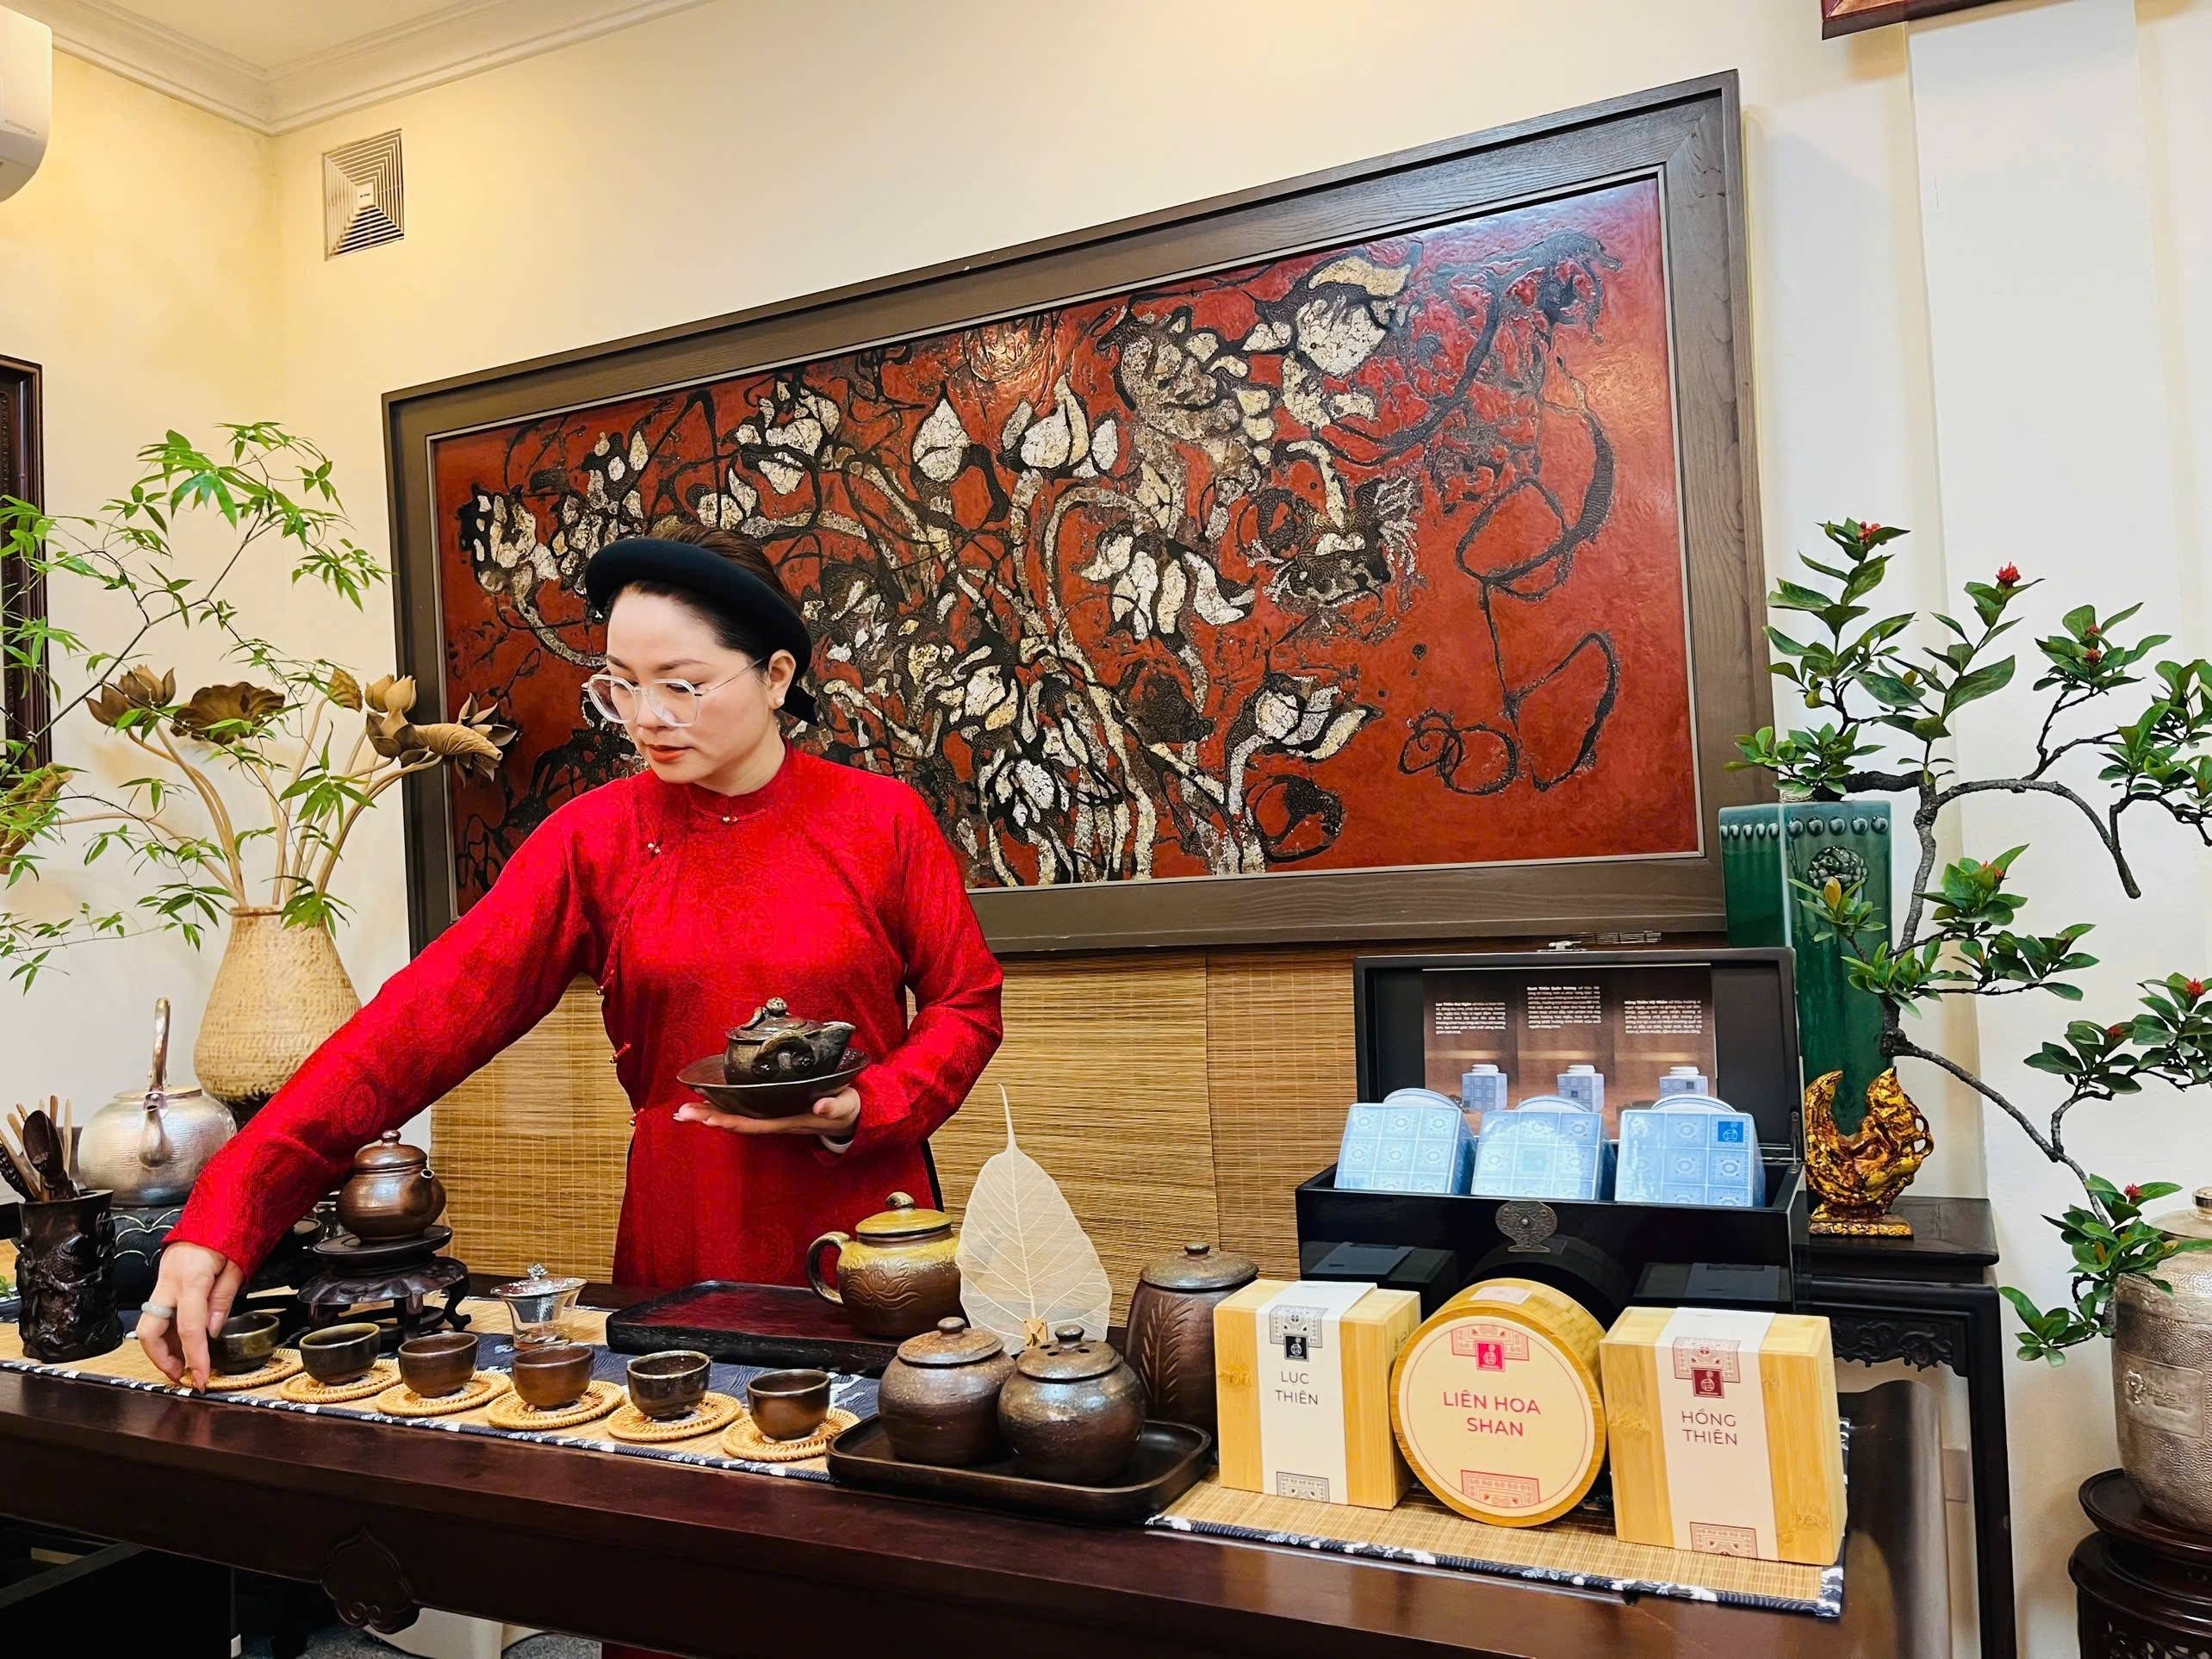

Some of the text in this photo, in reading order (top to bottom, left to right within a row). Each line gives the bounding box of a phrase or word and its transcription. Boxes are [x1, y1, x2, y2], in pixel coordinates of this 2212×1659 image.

[1275, 1389, 1318, 1405] THIÊN
[1443, 1389, 1541, 1414] LIÊN HOA
[1467, 1417, 1524, 1437] SHAN
[1681, 1429, 1737, 1445] THIÊN
